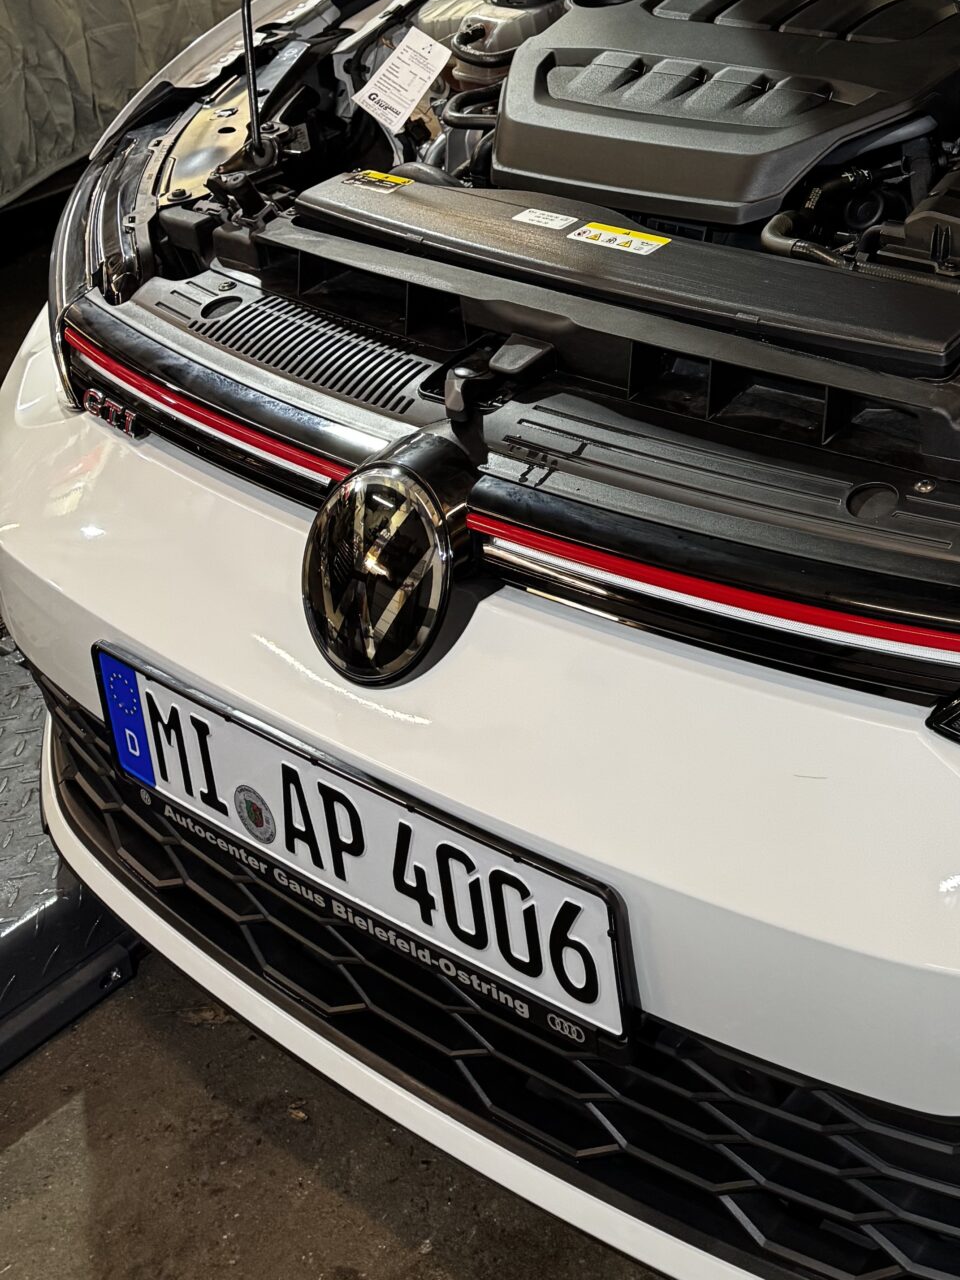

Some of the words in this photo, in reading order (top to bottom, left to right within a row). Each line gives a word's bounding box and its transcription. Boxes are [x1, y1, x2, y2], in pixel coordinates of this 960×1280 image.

[84, 388, 136, 439] GTI
[126, 729, 140, 756] D
[145, 691, 228, 815] MI
[281, 763, 364, 881] AP
[393, 819, 599, 1003] 4006
[163, 803, 268, 875] Autocenter
[273, 867, 326, 909] Gaus
[332, 897, 530, 1018] Bielefeld-Ostring
